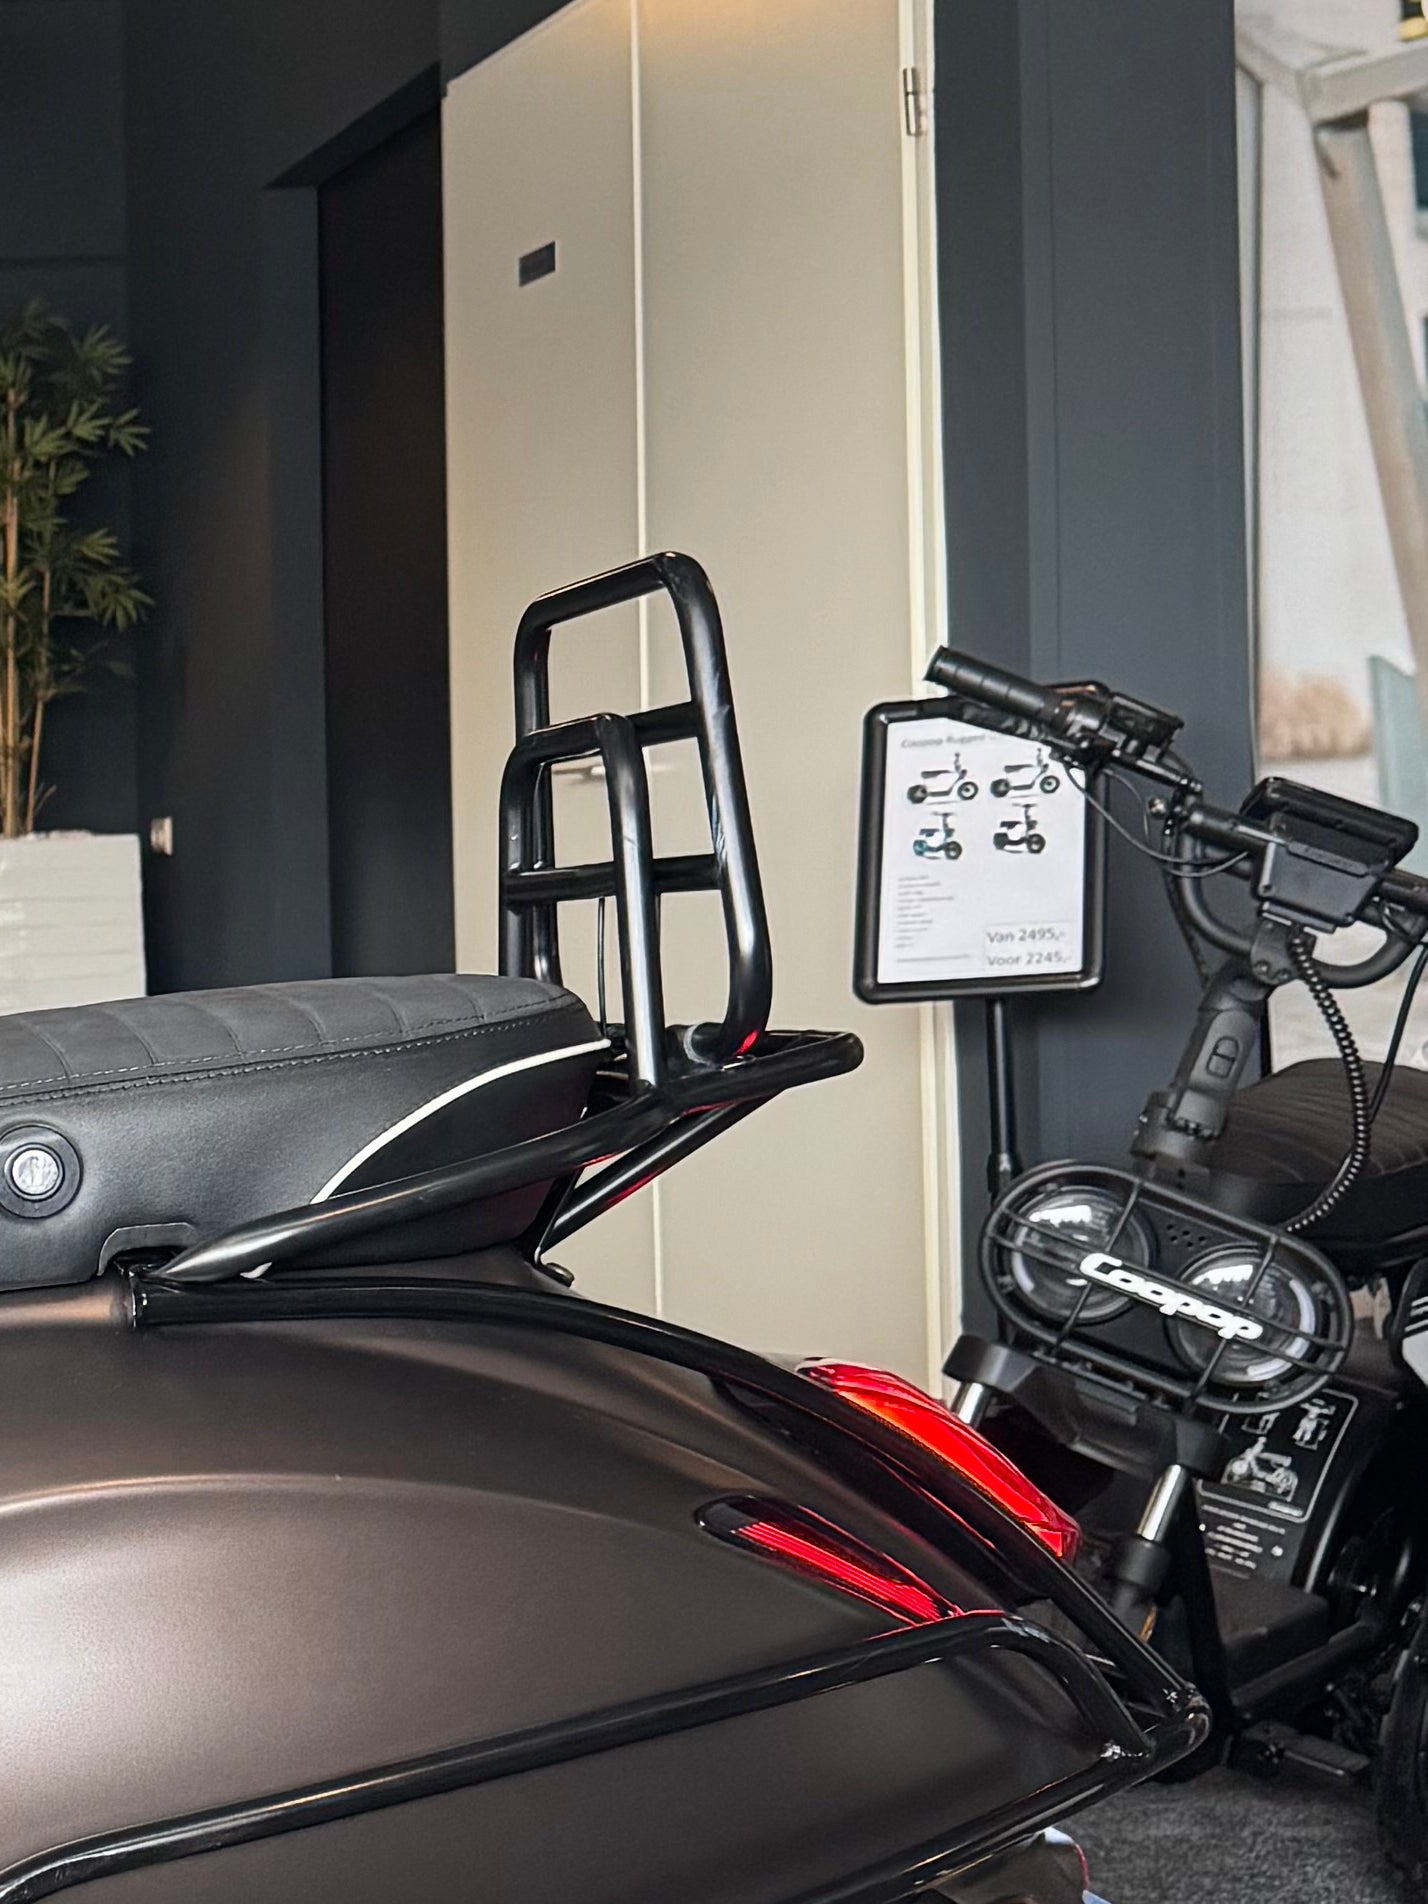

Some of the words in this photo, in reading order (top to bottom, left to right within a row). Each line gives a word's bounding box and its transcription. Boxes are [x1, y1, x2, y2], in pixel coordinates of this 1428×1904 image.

[987, 931, 1015, 944] Van
[987, 954, 1022, 967] Voor
[1079, 1252, 1264, 1340] Coopop
